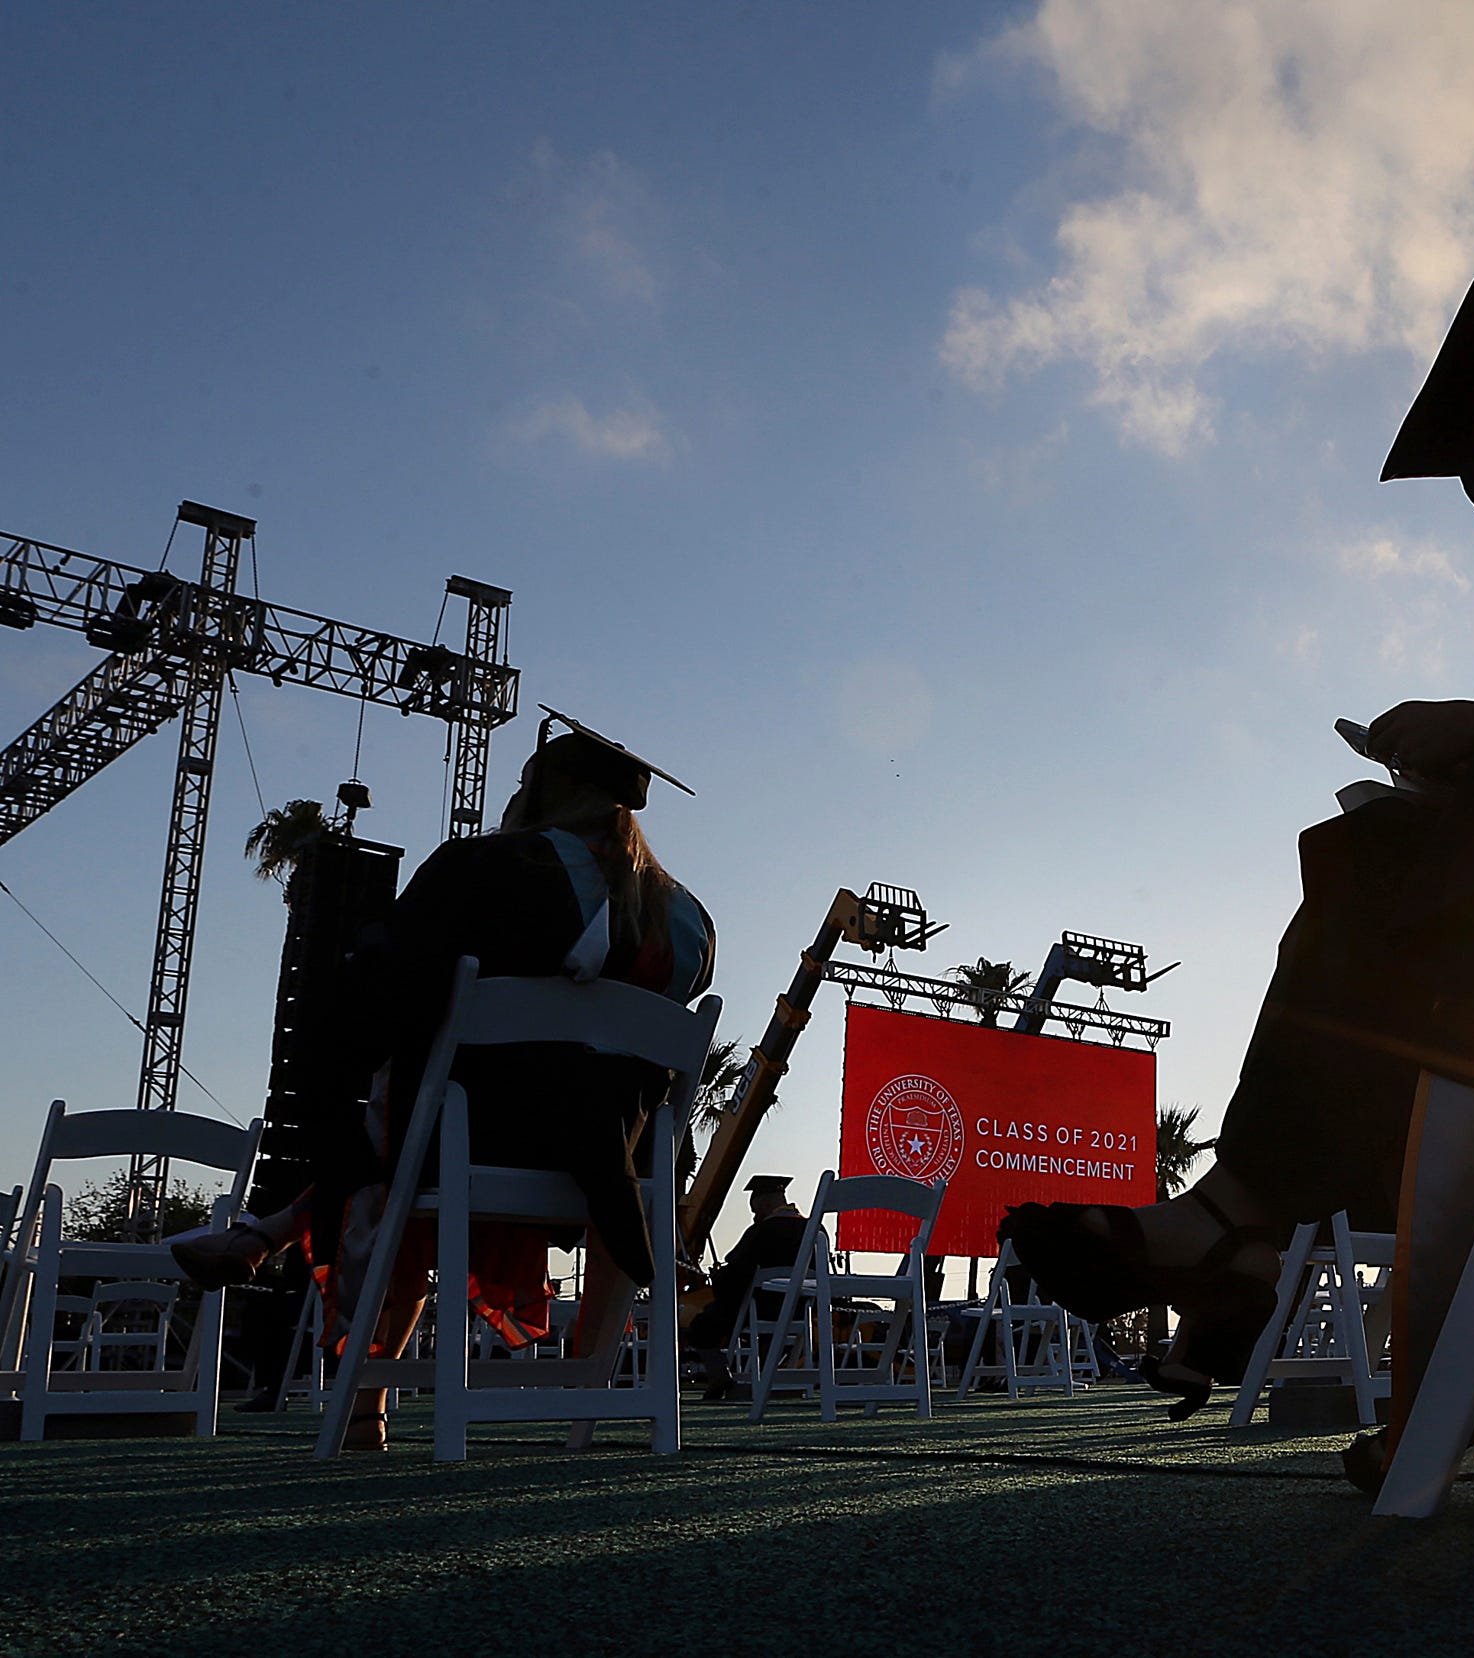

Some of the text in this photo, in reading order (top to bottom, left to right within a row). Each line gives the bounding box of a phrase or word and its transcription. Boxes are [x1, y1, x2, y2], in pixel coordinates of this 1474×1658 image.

[732, 1059, 758, 1114] JCB
[869, 1079, 961, 1140] THE UNIVERSITY OF TEXAS
[976, 1117, 1137, 1151] CLASS OF 2021
[872, 1146, 887, 1168] RIO
[975, 1150, 1135, 1181] COMMENCEMENT
